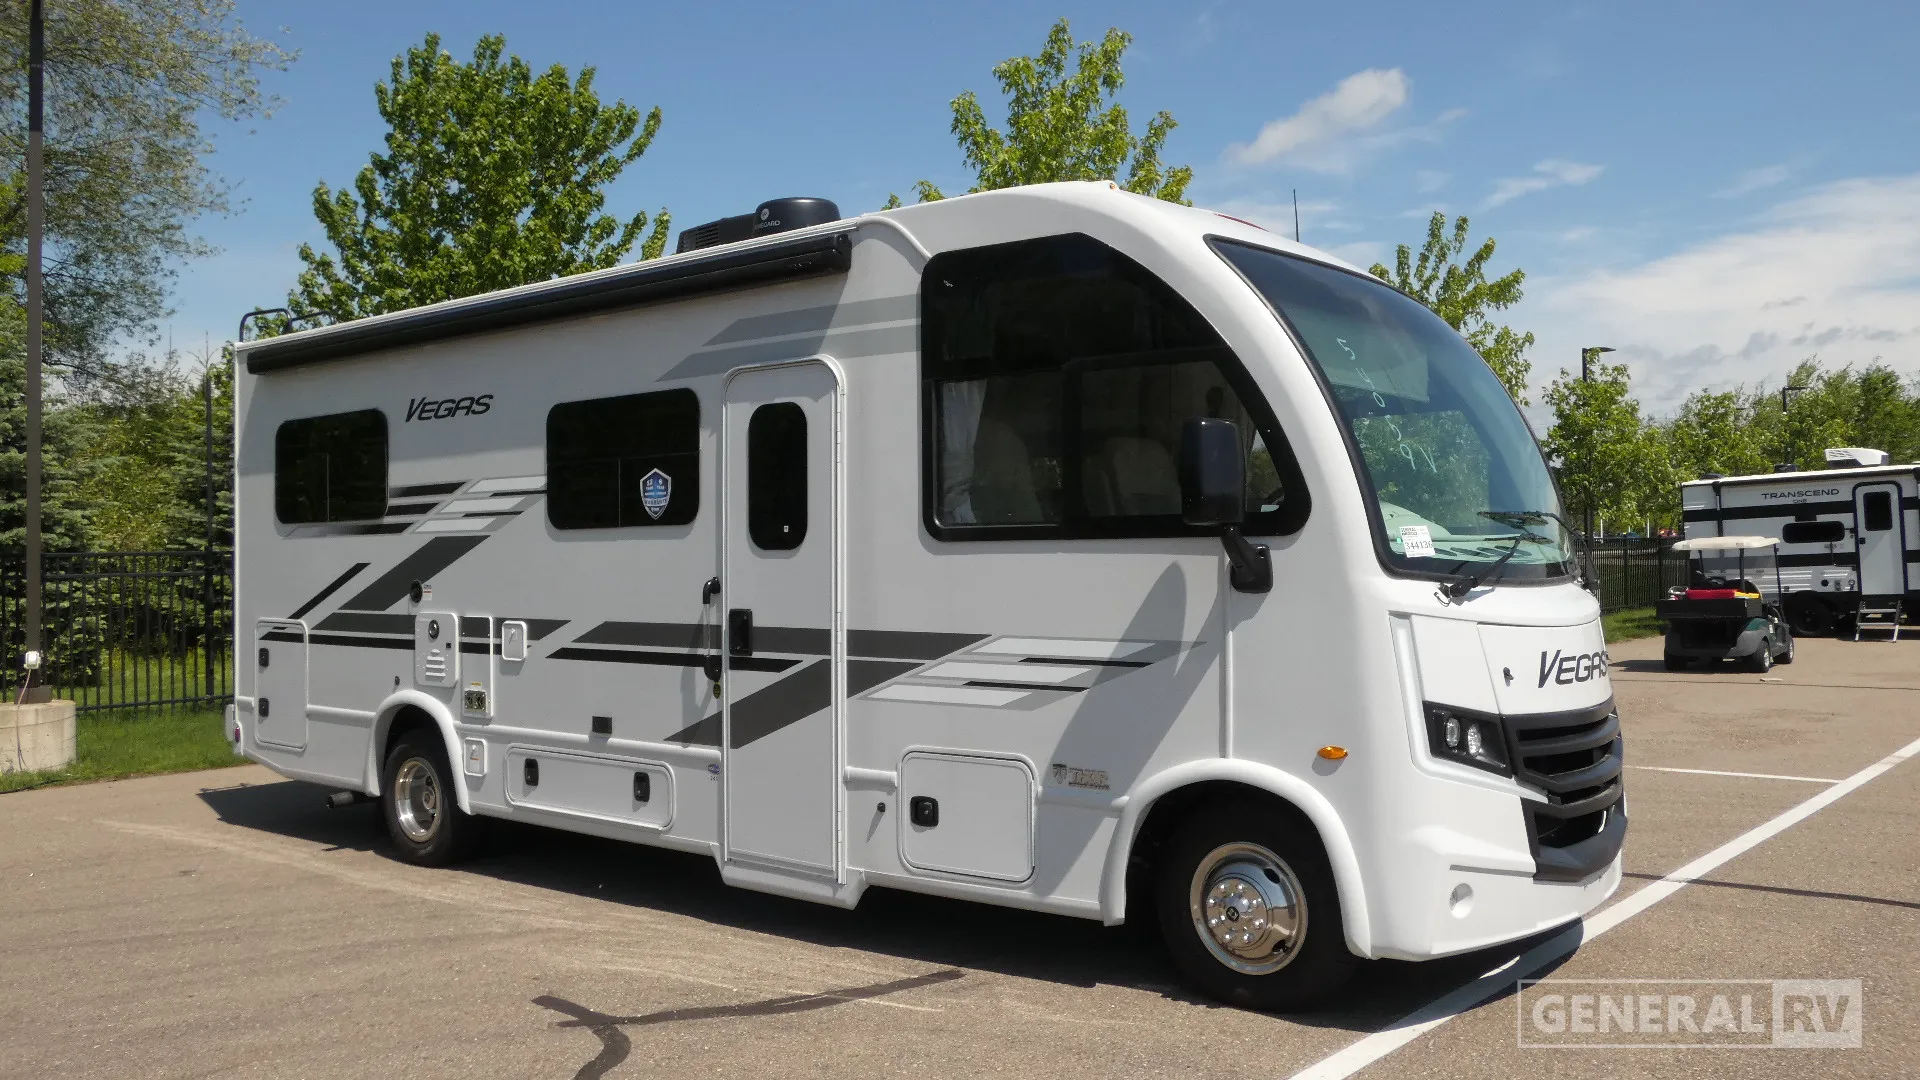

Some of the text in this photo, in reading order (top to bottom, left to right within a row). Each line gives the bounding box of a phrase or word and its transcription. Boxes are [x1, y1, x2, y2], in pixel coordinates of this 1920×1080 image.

[405, 394, 494, 423] VEGAS
[1761, 489, 1840, 499] TRANSCEND
[1538, 649, 1608, 688] VEGAS
